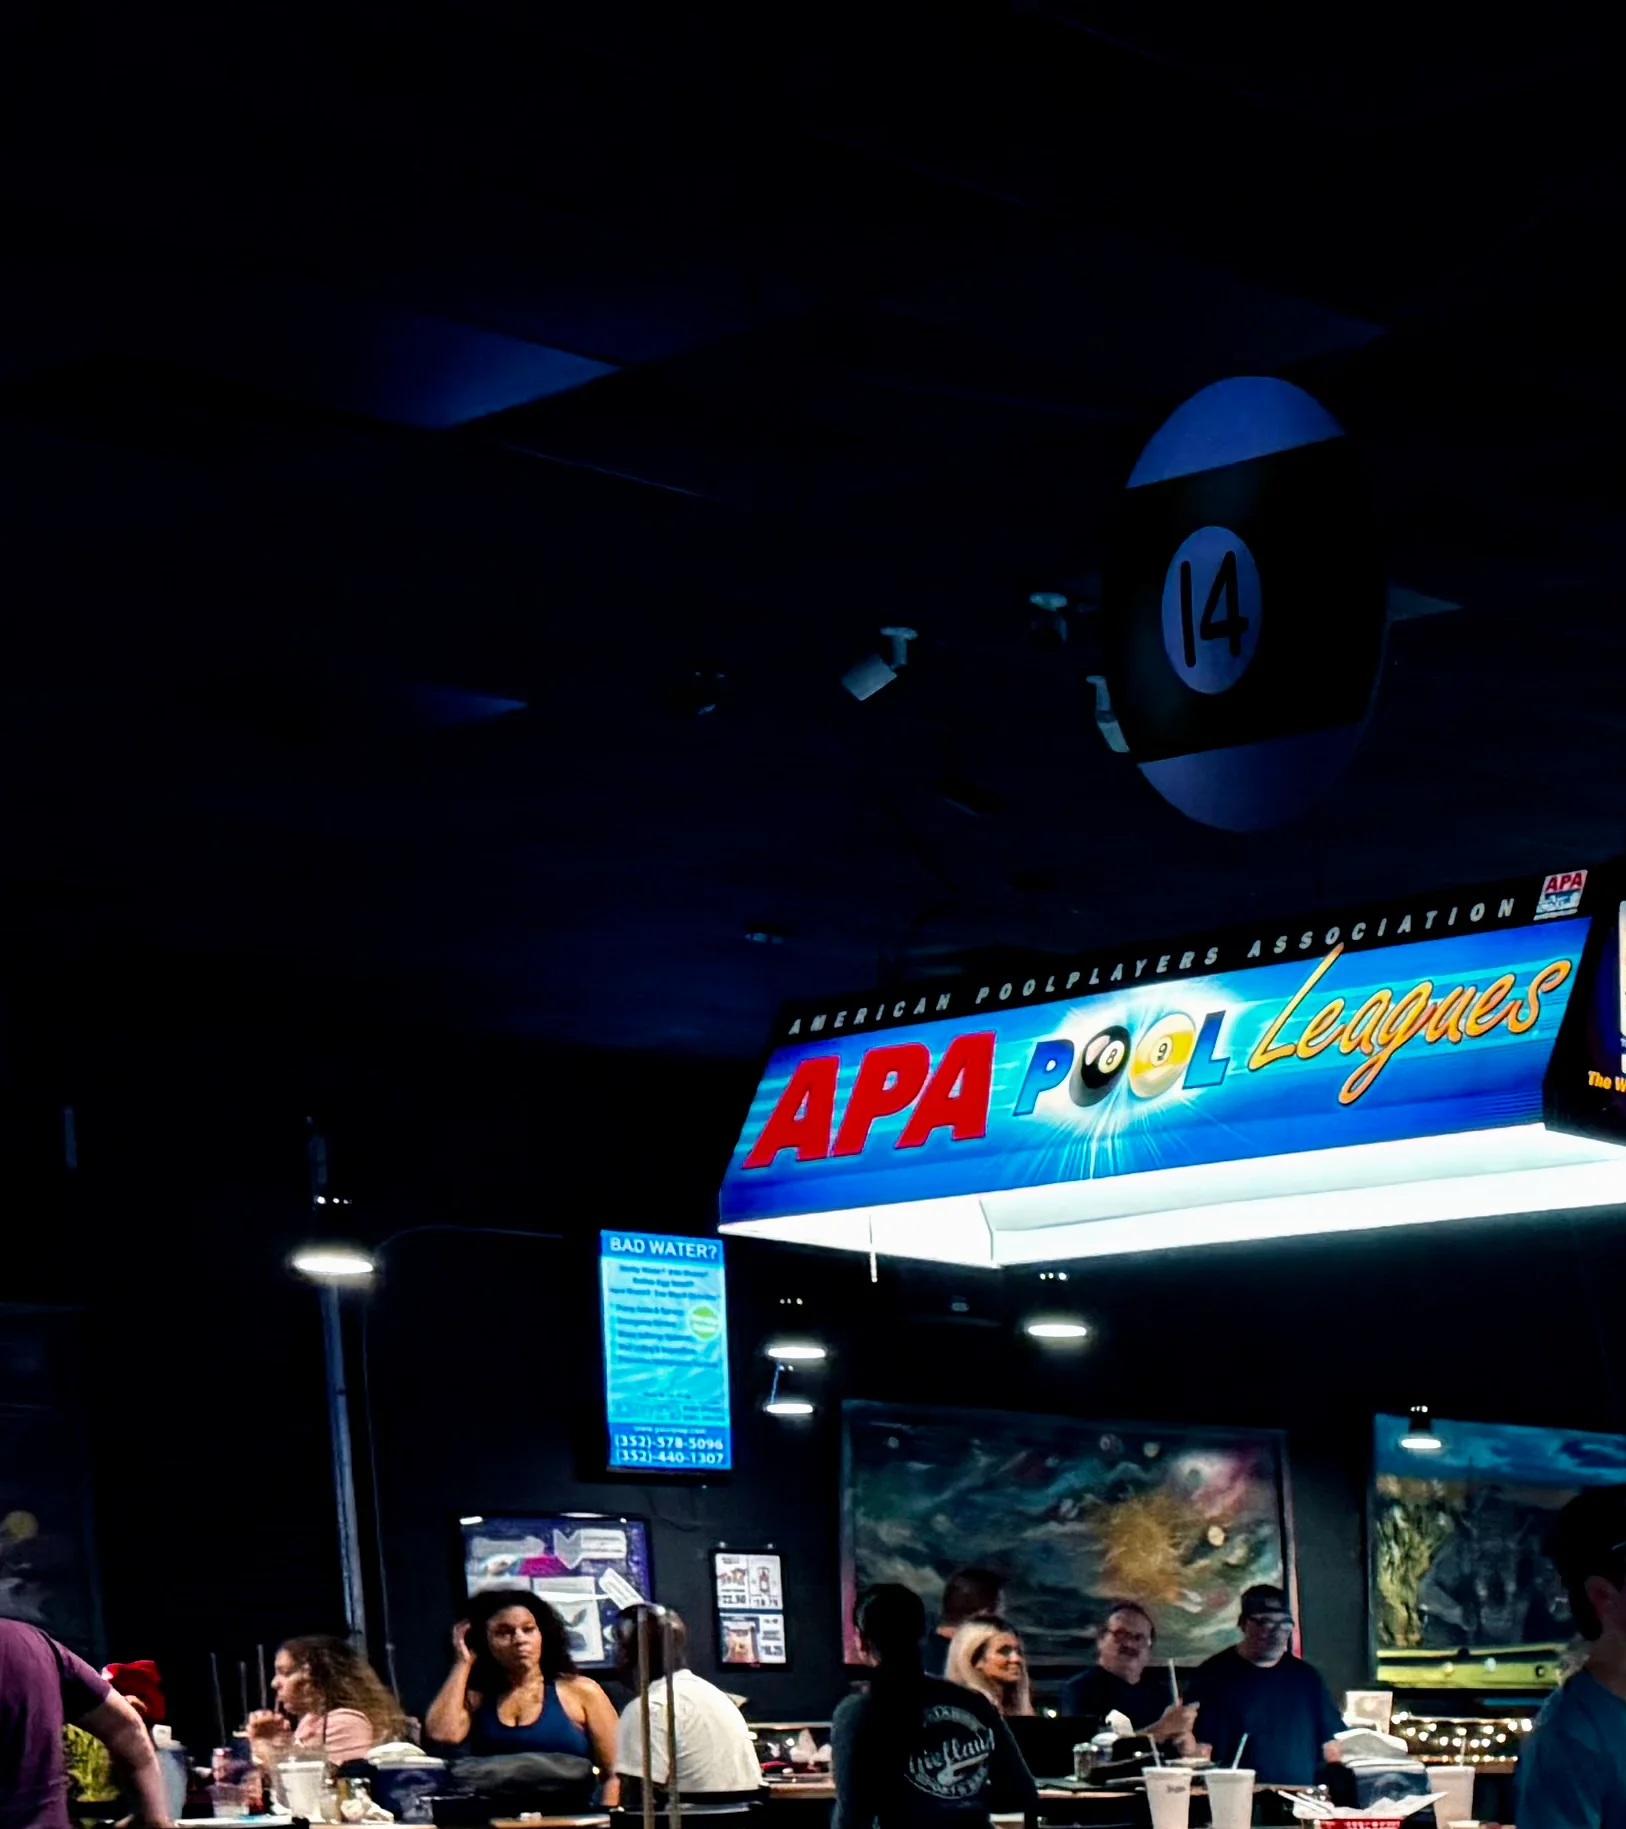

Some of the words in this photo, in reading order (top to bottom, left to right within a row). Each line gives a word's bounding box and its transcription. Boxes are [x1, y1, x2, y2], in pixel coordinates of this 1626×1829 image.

[1177, 550, 1250, 668] 14
[1544, 871, 1583, 893] APA
[788, 992, 951, 1036] AMERICAN
[975, 946, 1218, 1005] POOLPLAYERS
[1246, 897, 1516, 959] ASSOCIATION
[742, 1030, 997, 1171] APA
[1012, 1005, 1231, 1117] POOL
[1246, 943, 1571, 1107] Leagues
[1588, 1070, 1612, 1090] The
[609, 1236, 646, 1254] BAD
[649, 1239, 718, 1260] WATER?
